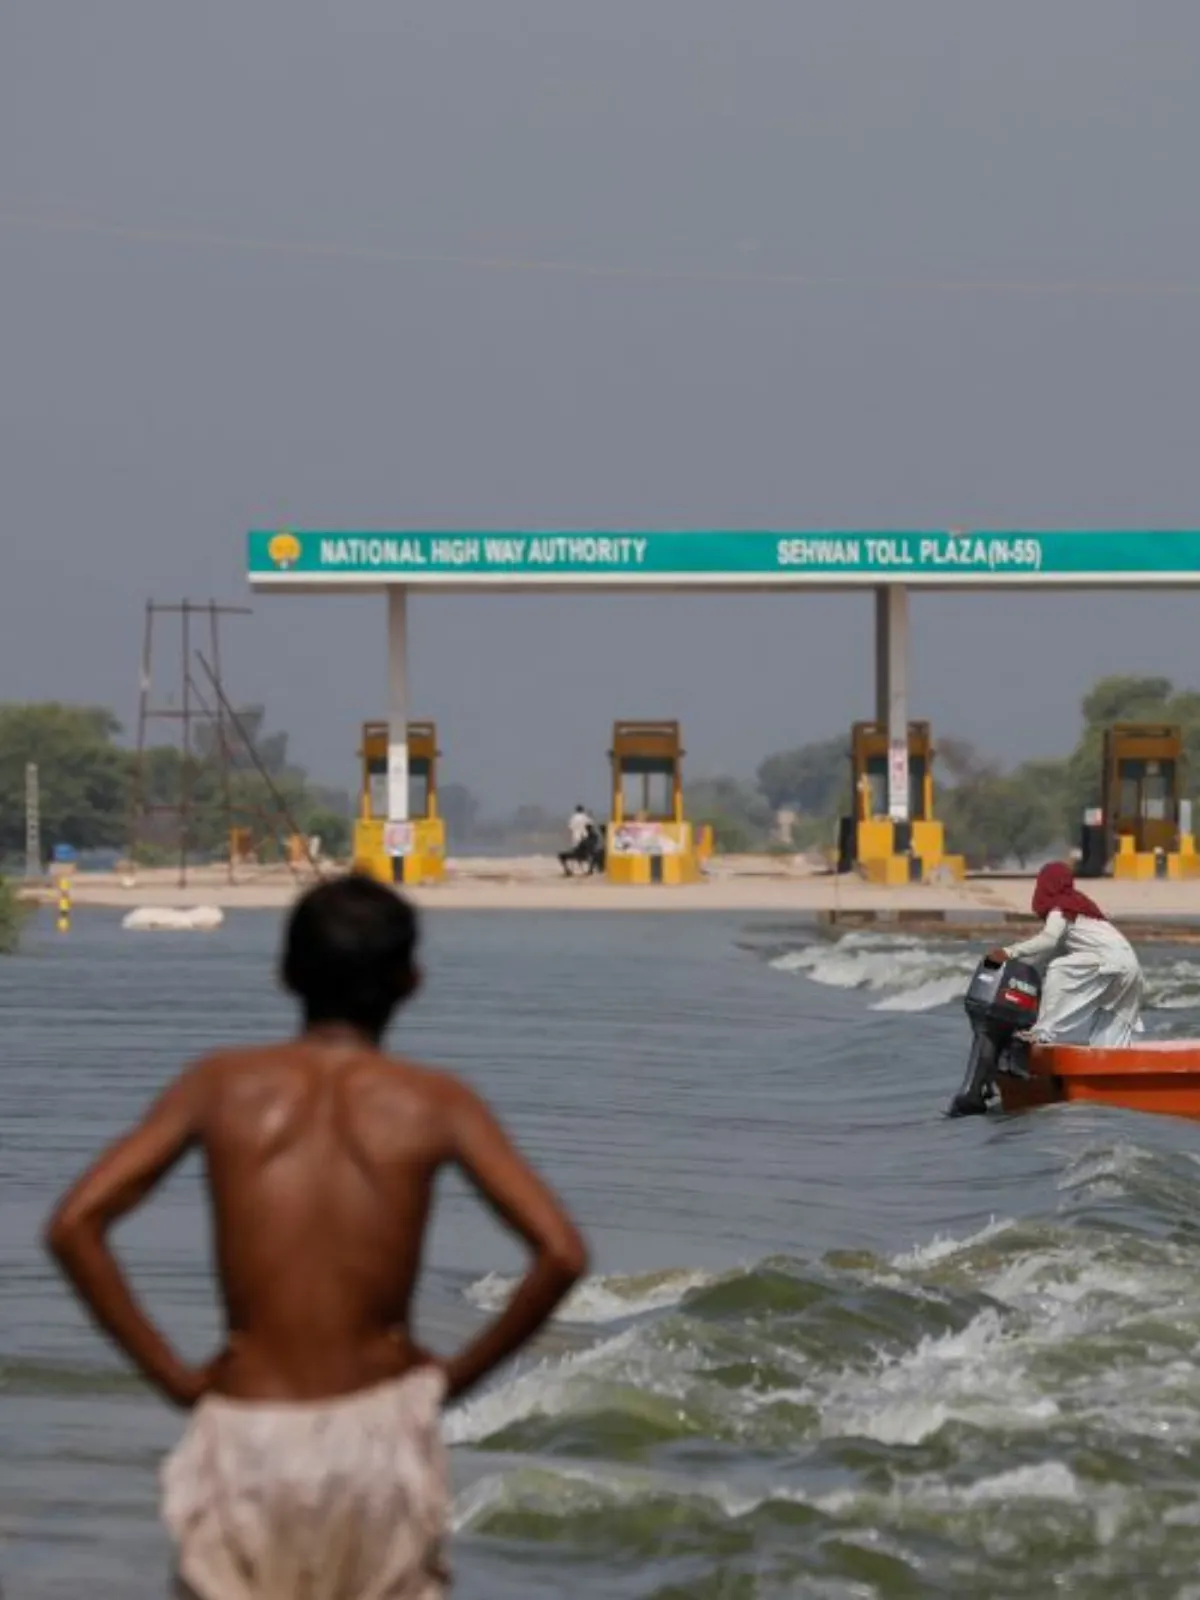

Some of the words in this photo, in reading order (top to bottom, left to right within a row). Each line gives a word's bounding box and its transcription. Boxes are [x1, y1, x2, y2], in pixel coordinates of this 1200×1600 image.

[321, 539, 427, 564] NATIONAL
[431, 539, 478, 564] HIGH
[484, 539, 527, 563] WAY
[529, 538, 647, 563] AUTHORITY
[777, 539, 859, 565] SEHWAN
[864, 539, 913, 564] TOLL
